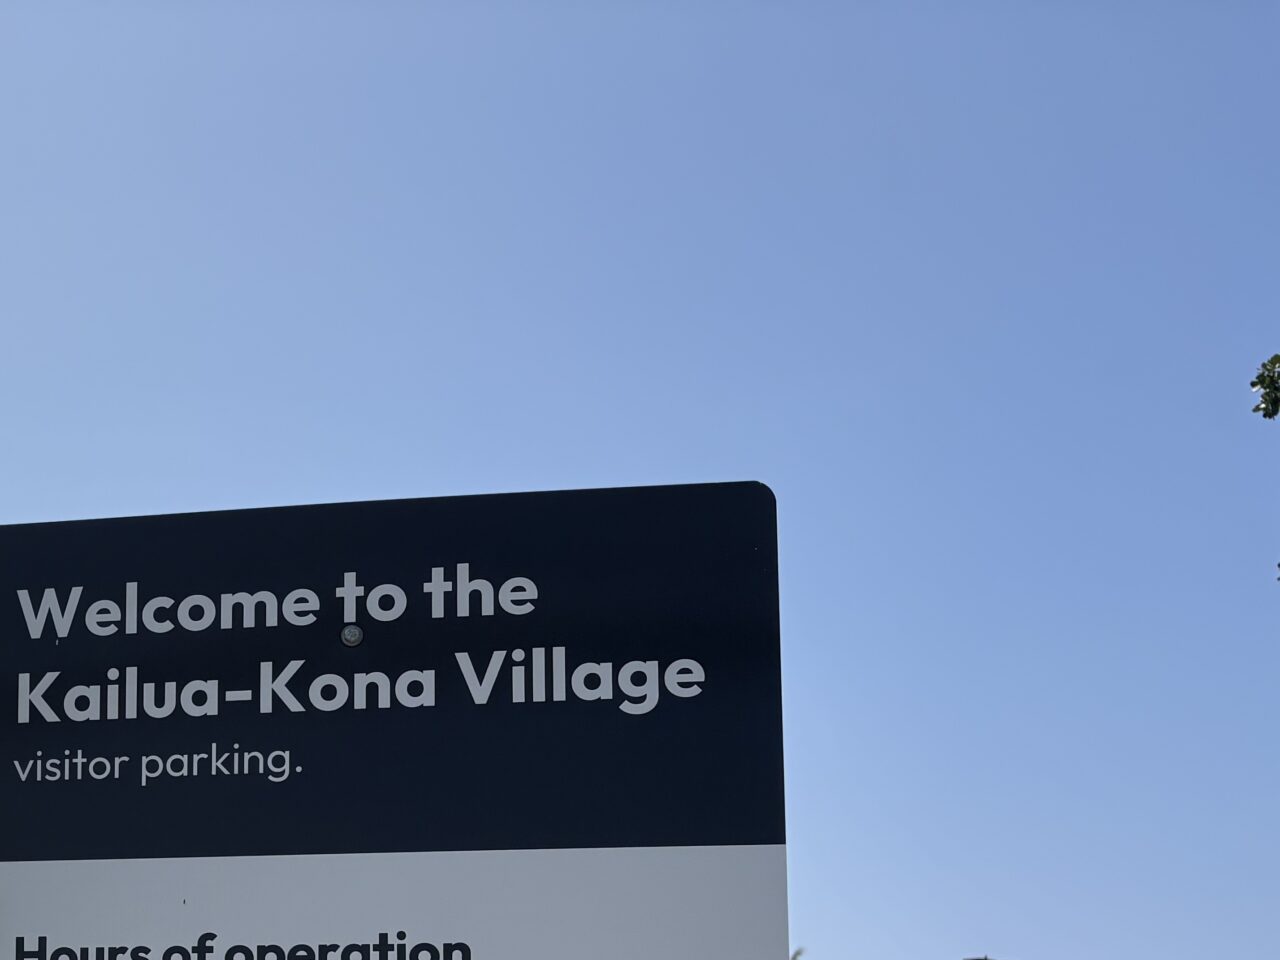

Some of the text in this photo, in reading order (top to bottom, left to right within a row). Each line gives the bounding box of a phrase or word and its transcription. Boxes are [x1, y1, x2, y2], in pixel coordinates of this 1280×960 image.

[17, 563, 538, 639] Welcome to the
[18, 646, 705, 723] Kailua-Kona Village
[13, 743, 302, 787] visitor parking.
